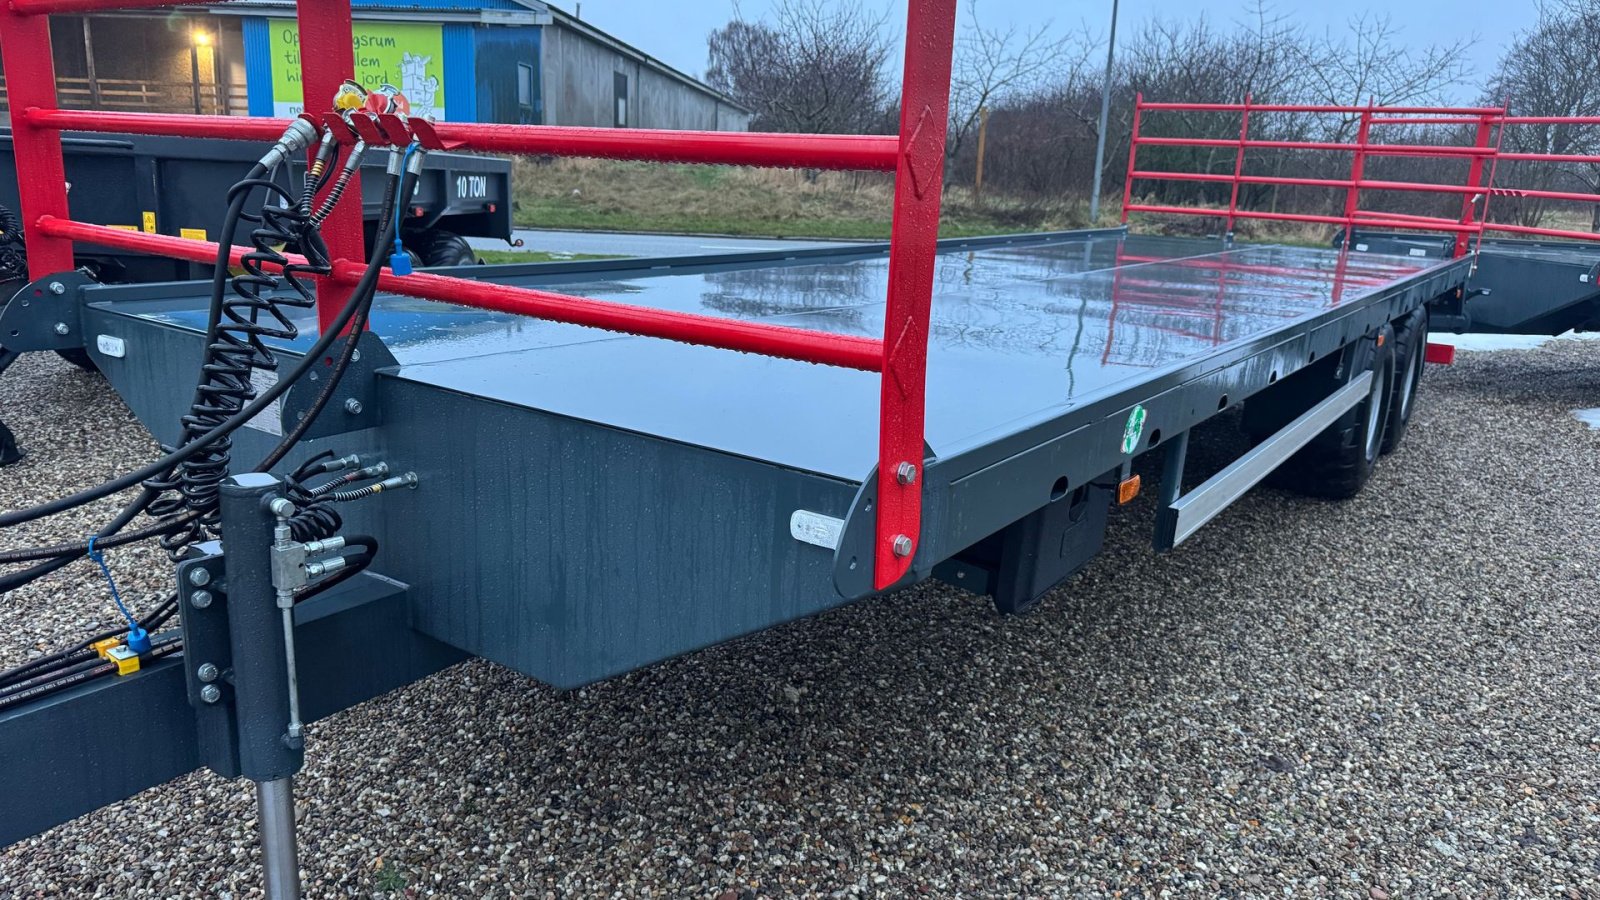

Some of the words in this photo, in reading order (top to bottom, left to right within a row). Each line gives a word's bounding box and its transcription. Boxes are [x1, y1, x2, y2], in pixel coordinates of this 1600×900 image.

[361, 70, 389, 86] jord
[456, 175, 467, 198] 10
[468, 175, 487, 198] TON
